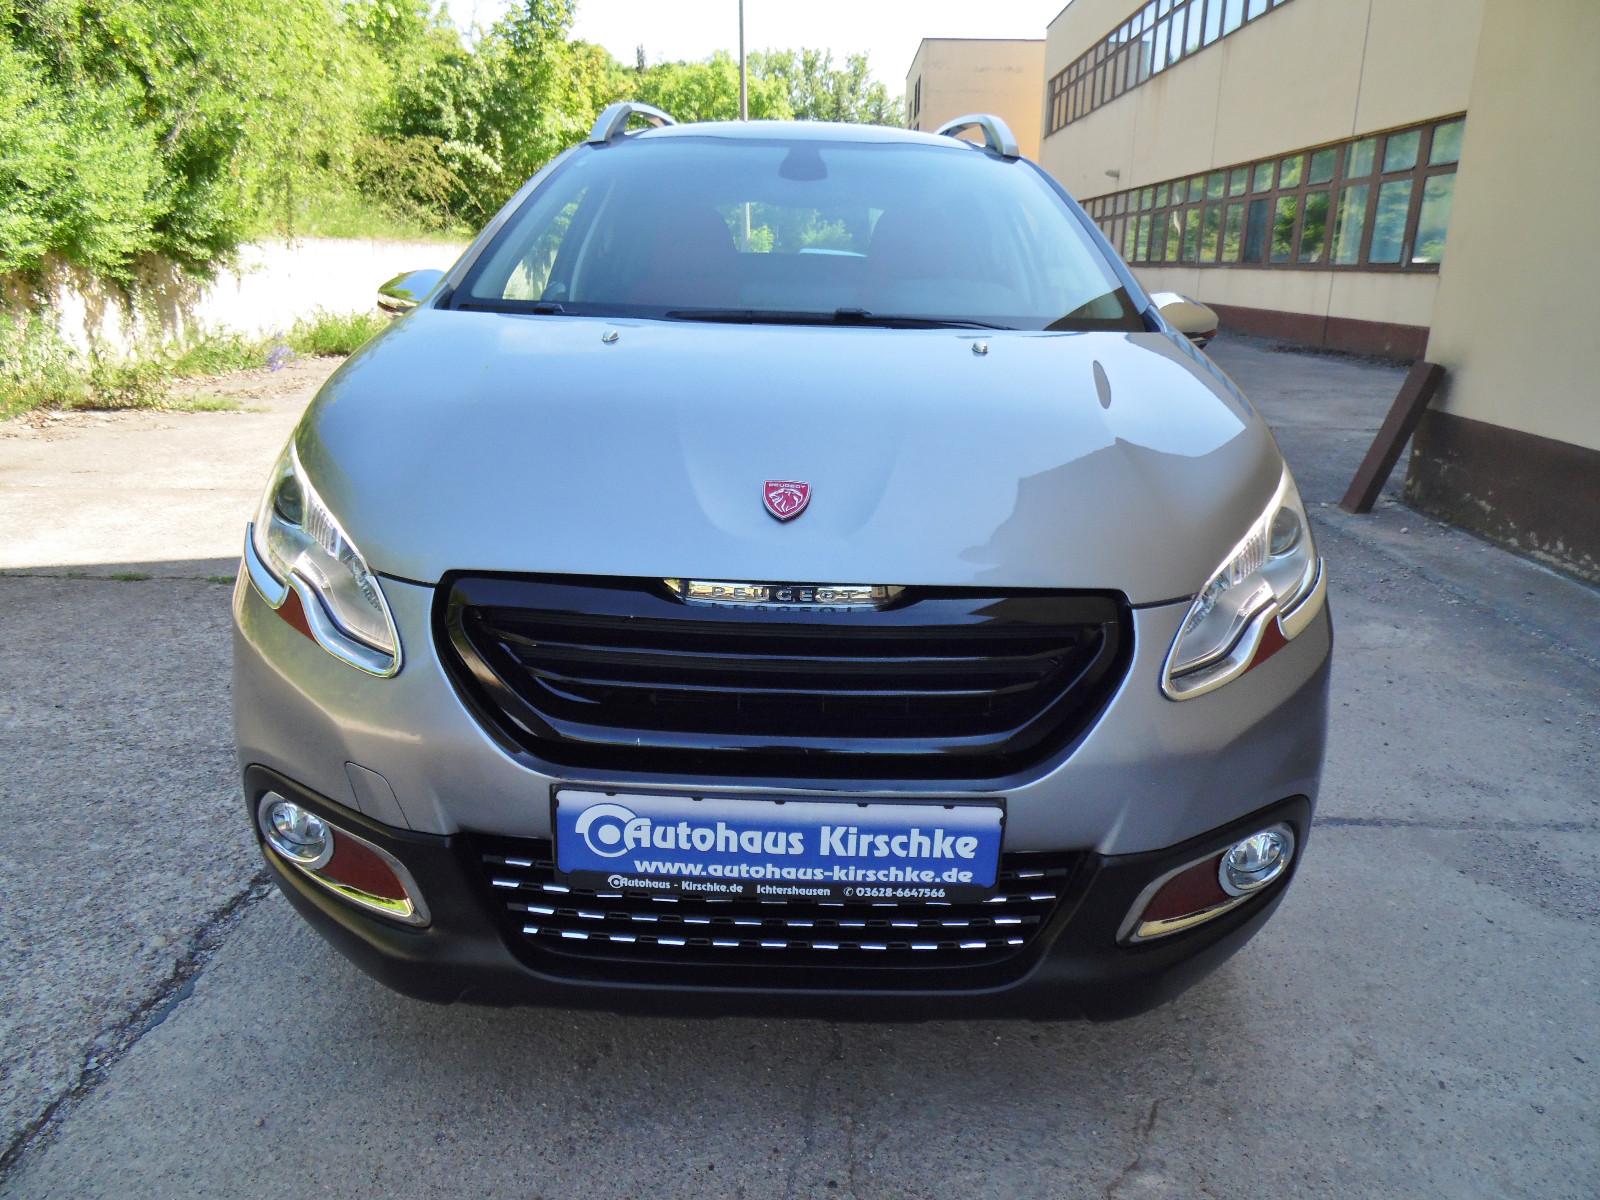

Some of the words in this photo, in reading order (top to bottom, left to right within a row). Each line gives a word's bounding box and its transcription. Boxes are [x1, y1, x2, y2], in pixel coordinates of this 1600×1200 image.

[711, 585, 859, 602] PEUGEOT
[624, 818, 804, 855] Autohaus
[820, 826, 978, 859] Kirschke
[634, 860, 974, 883] www.autohaus-kirschke.de
[620, 877, 671, 889] Autohaus
[681, 881, 744, 893] Kirschke.de
[757, 884, 831, 896] Ichtershausen
[856, 887, 946, 898] 03628-6647566
